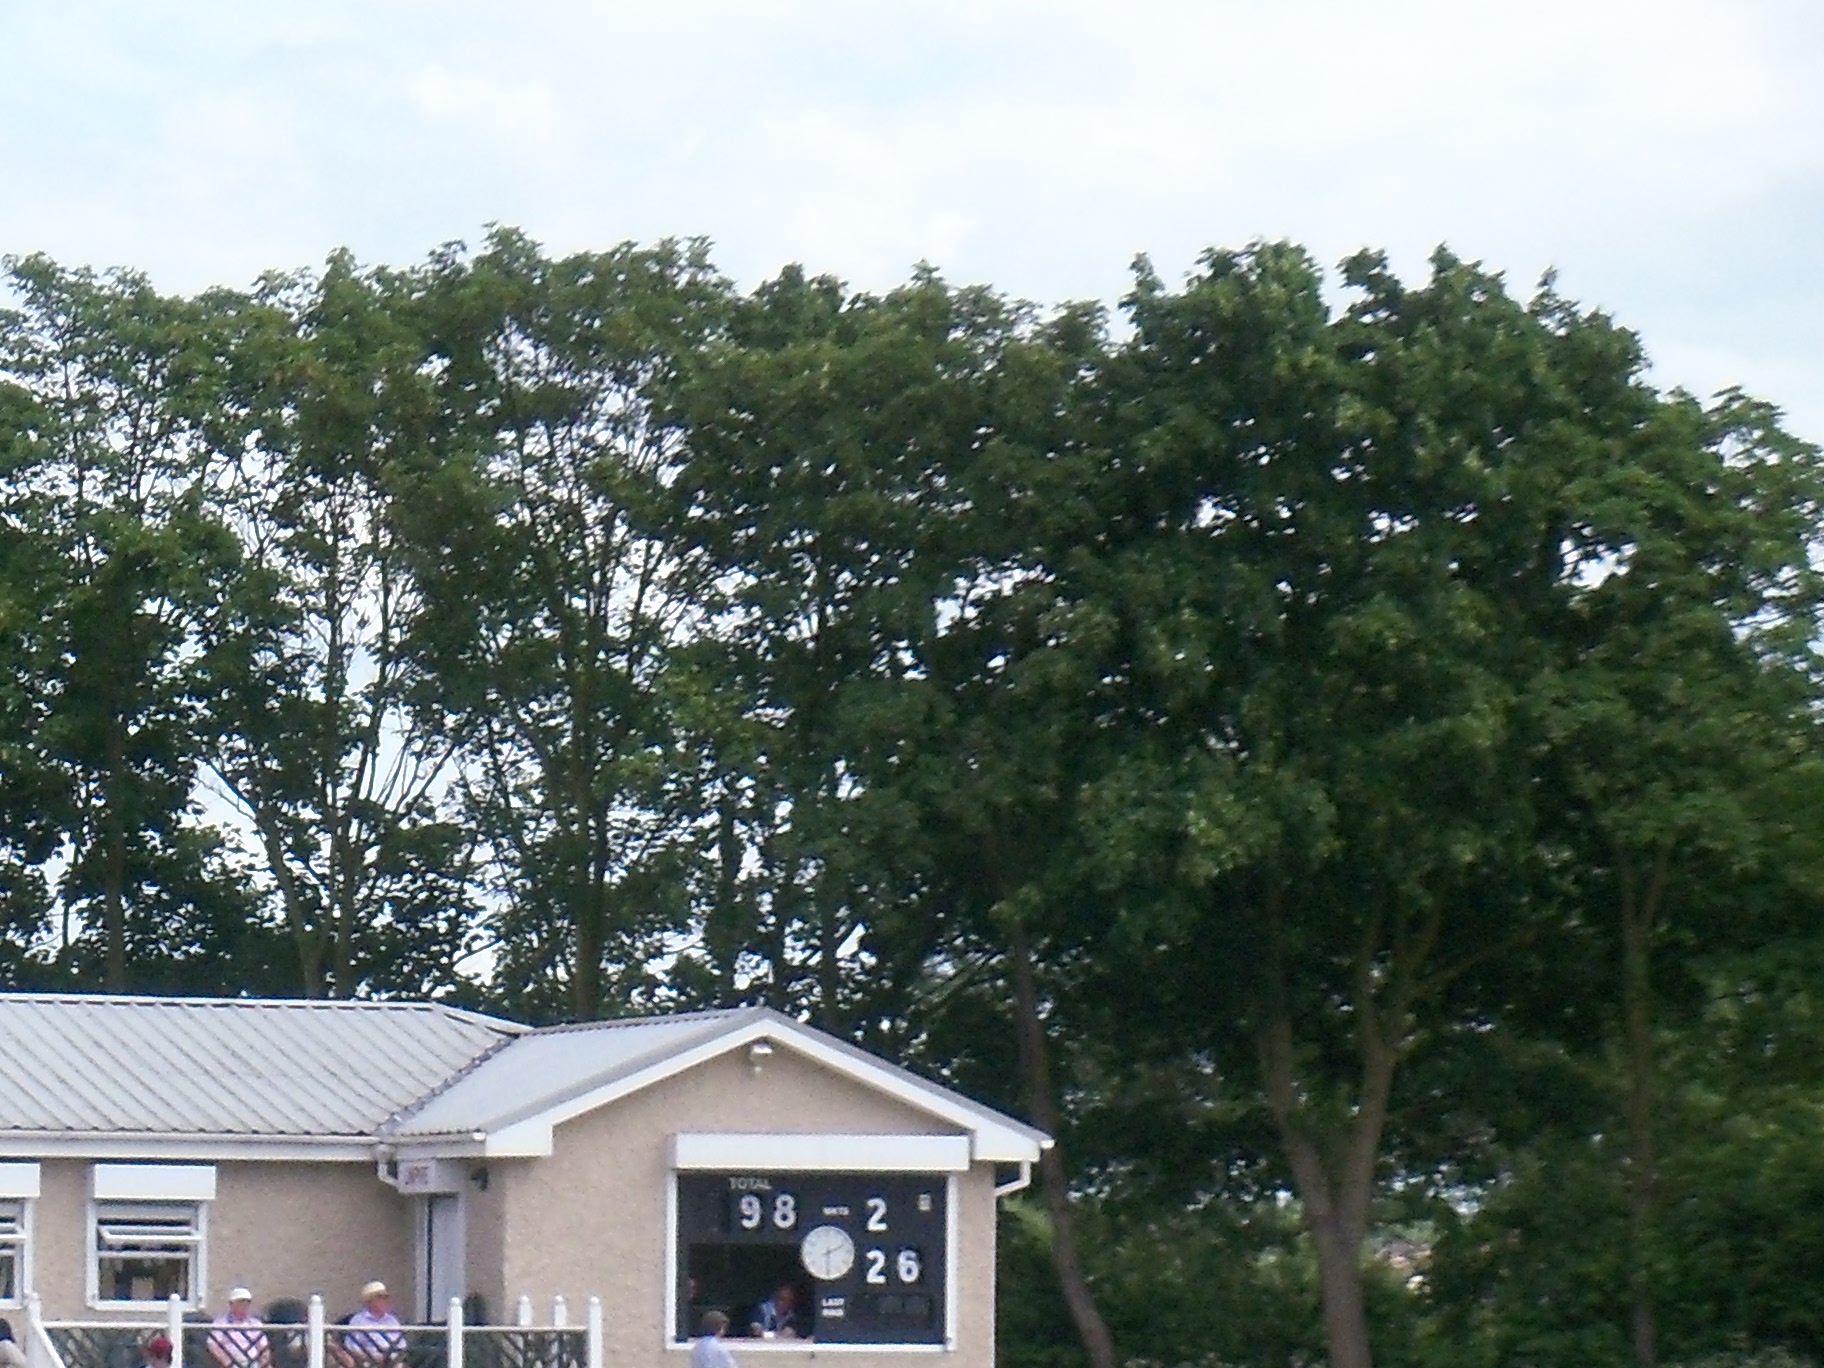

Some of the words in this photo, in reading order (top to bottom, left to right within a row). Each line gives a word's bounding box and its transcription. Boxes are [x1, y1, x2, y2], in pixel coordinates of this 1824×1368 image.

[729, 1177, 772, 1190] TOTAL
[739, 1194, 797, 1229] 98
[866, 1197, 888, 1232] 2
[866, 1249, 920, 1284] 26
